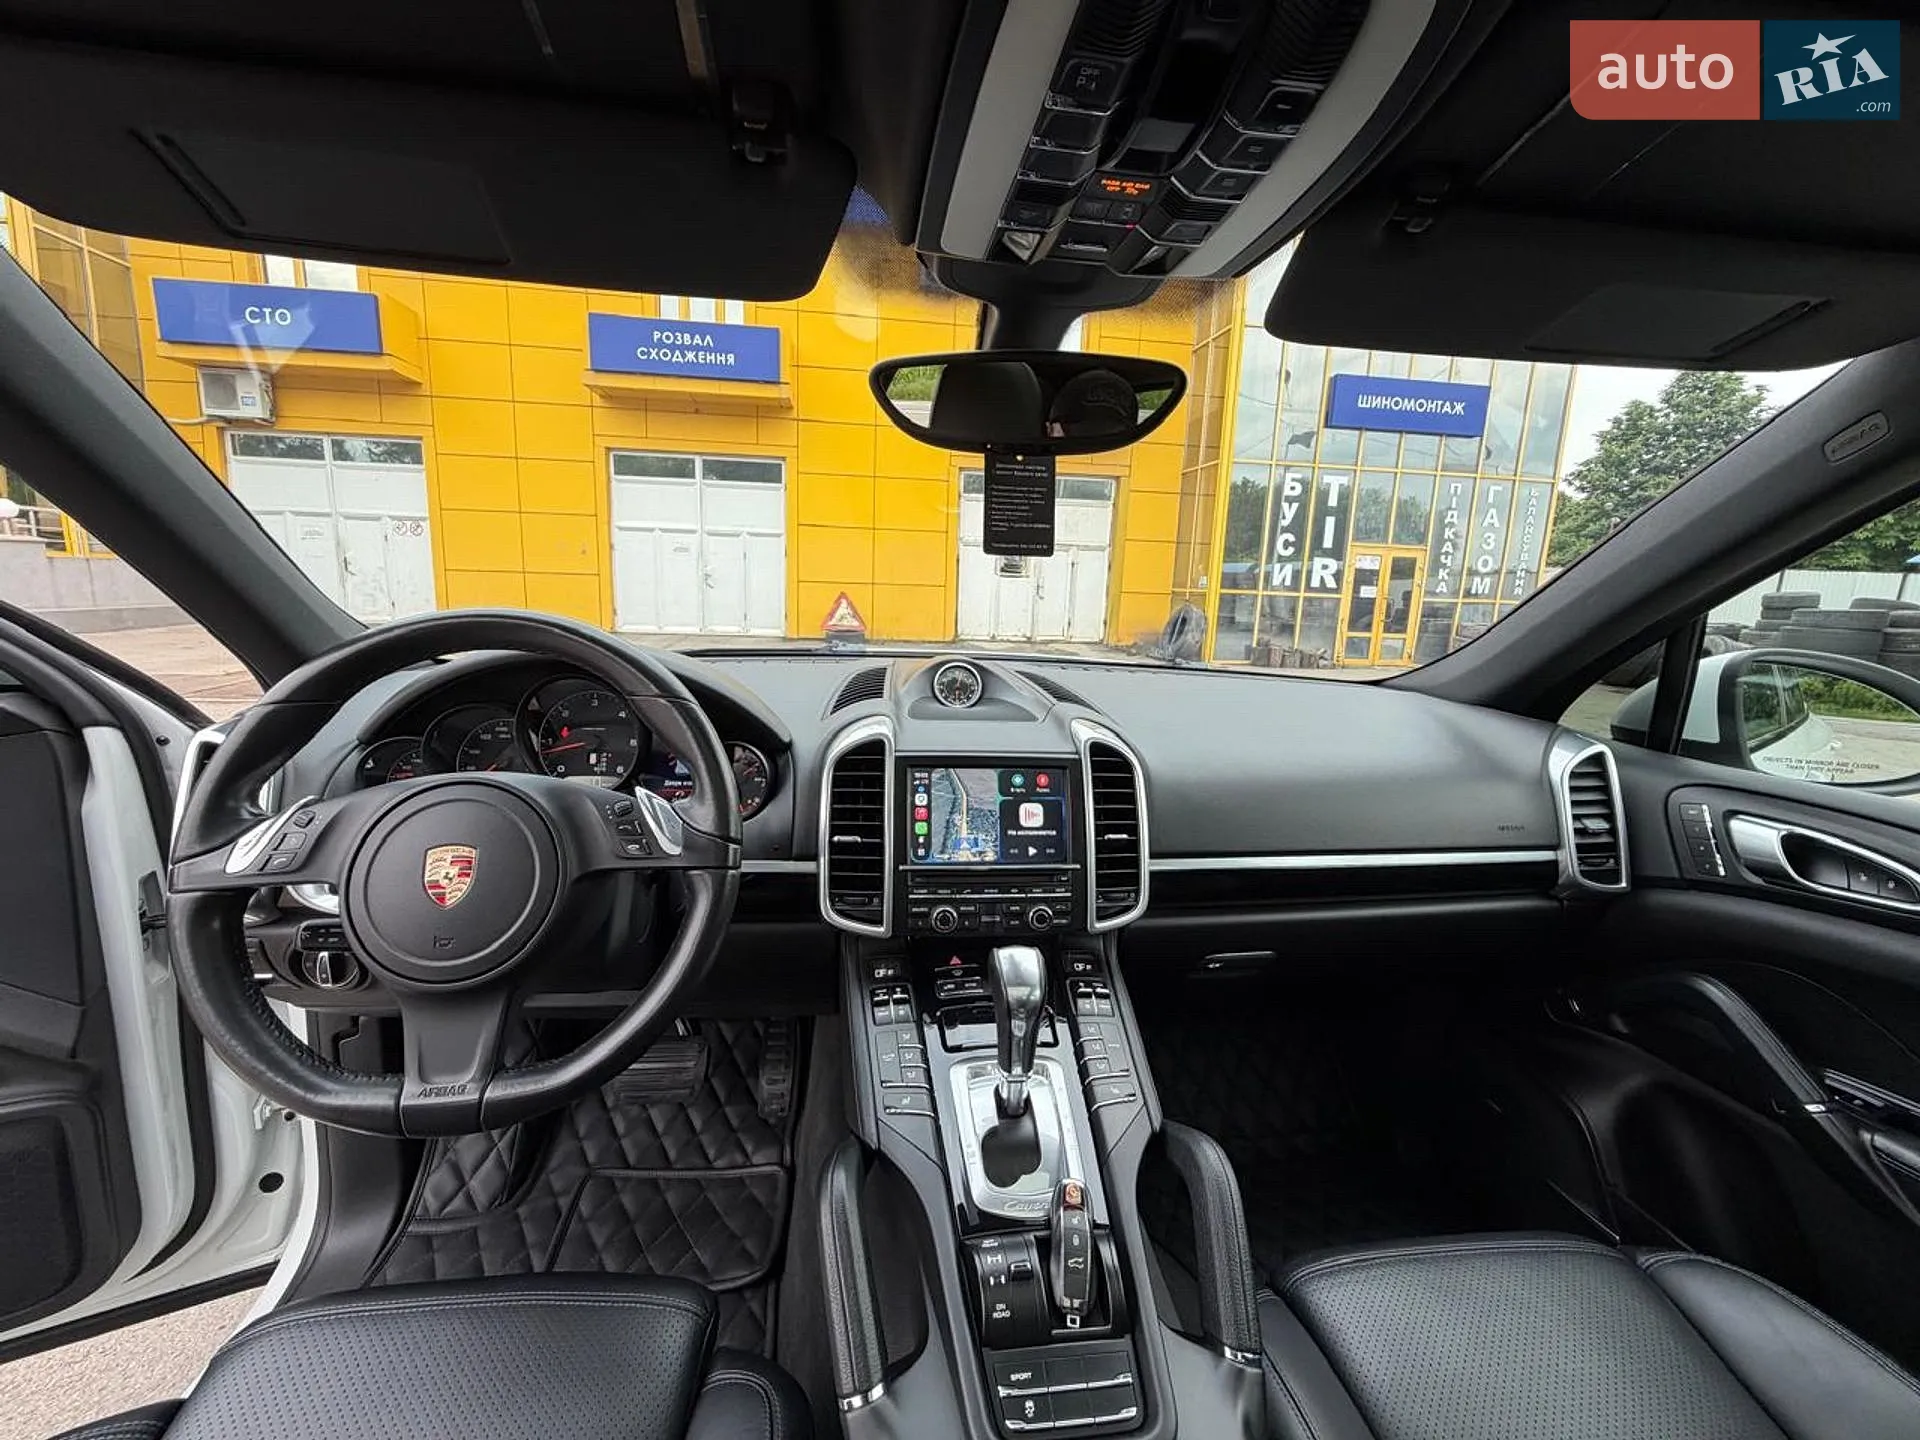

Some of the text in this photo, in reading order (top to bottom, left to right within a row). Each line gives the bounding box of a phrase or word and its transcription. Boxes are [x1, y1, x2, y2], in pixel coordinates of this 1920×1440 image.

[245, 306, 291, 326] СТО
[653, 330, 714, 348] РОЗВАЛ
[636, 346, 736, 367] СХОДЖЕННЯ
[1357, 393, 1466, 416] ШИНОМОНТАЖ
[1271, 472, 1303, 587] БУСИ
[1310, 475, 1349, 589] TIR
[1436, 482, 1463, 594] ПІДКАЧКА
[1471, 485, 1503, 595] ГАЗОМ
[1010, 1372, 1032, 1381] SPORT
